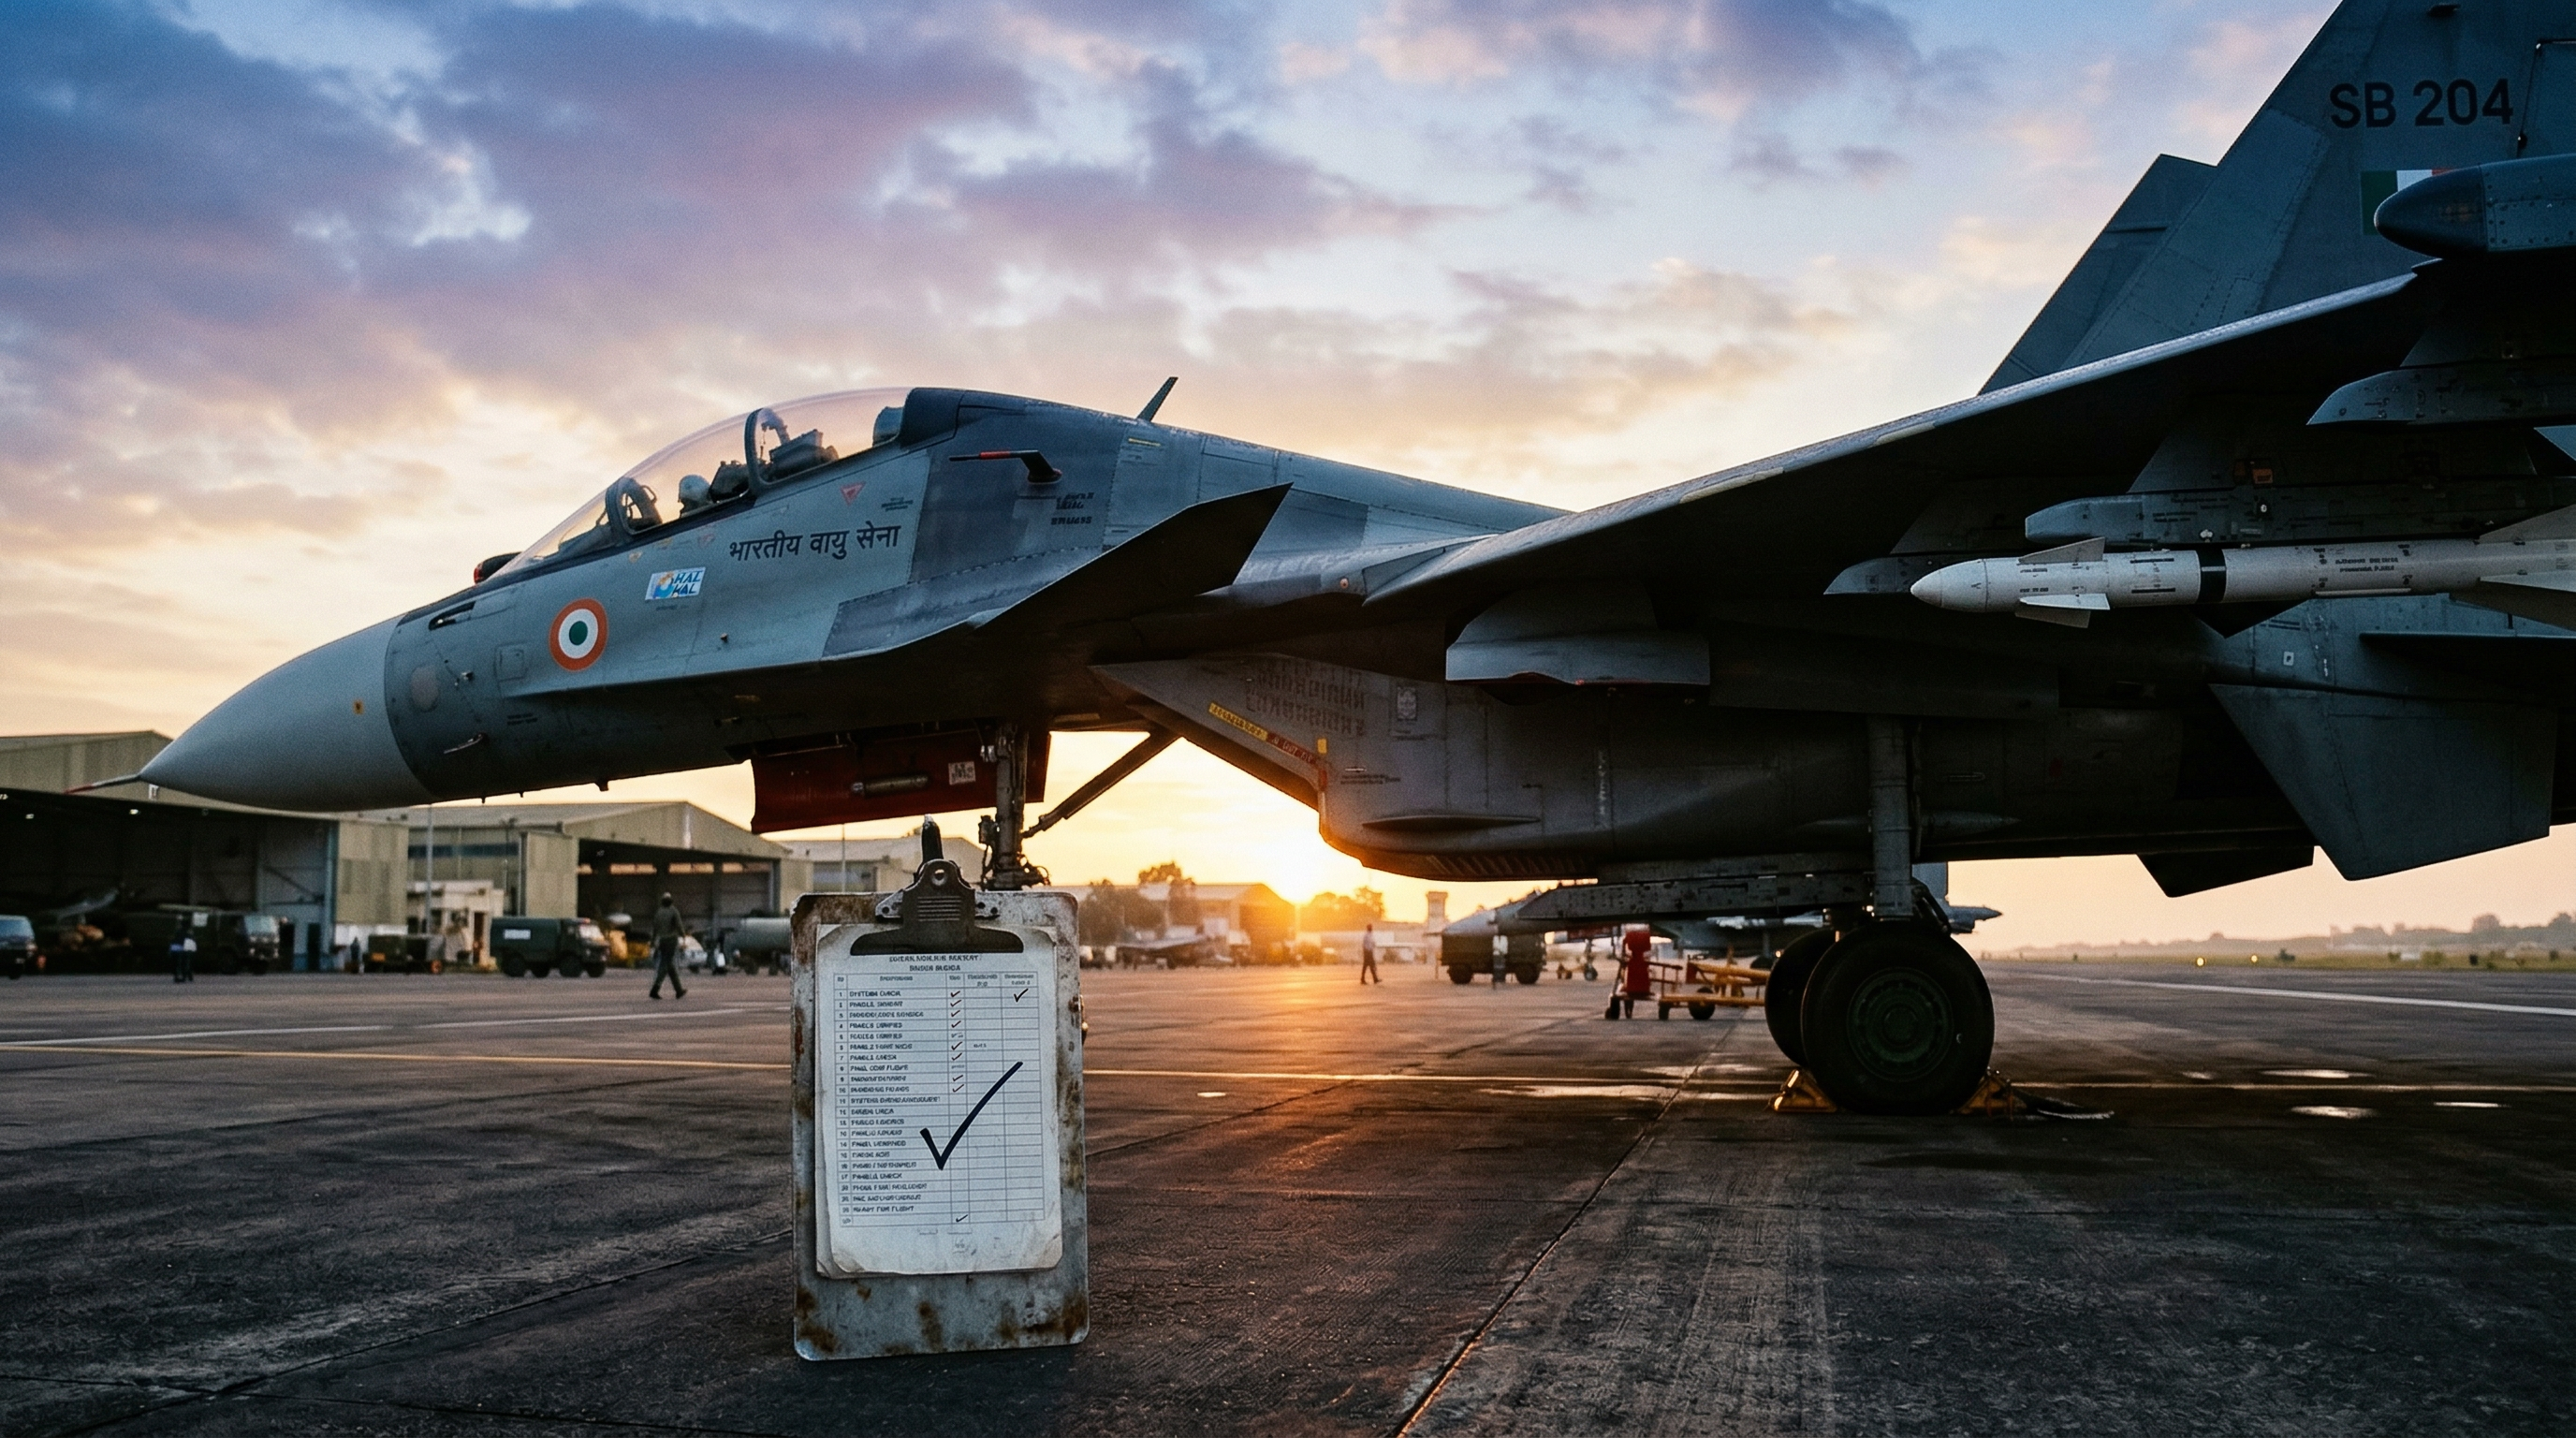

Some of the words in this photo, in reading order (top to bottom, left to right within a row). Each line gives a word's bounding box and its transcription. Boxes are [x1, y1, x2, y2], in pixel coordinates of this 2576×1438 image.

[2329, 81, 2396, 128] SB
[2412, 78, 2513, 126] 204
[729, 529, 803, 562] भारतीय
[810, 529, 850, 560] वायु
[856, 521, 901, 550] सेना
